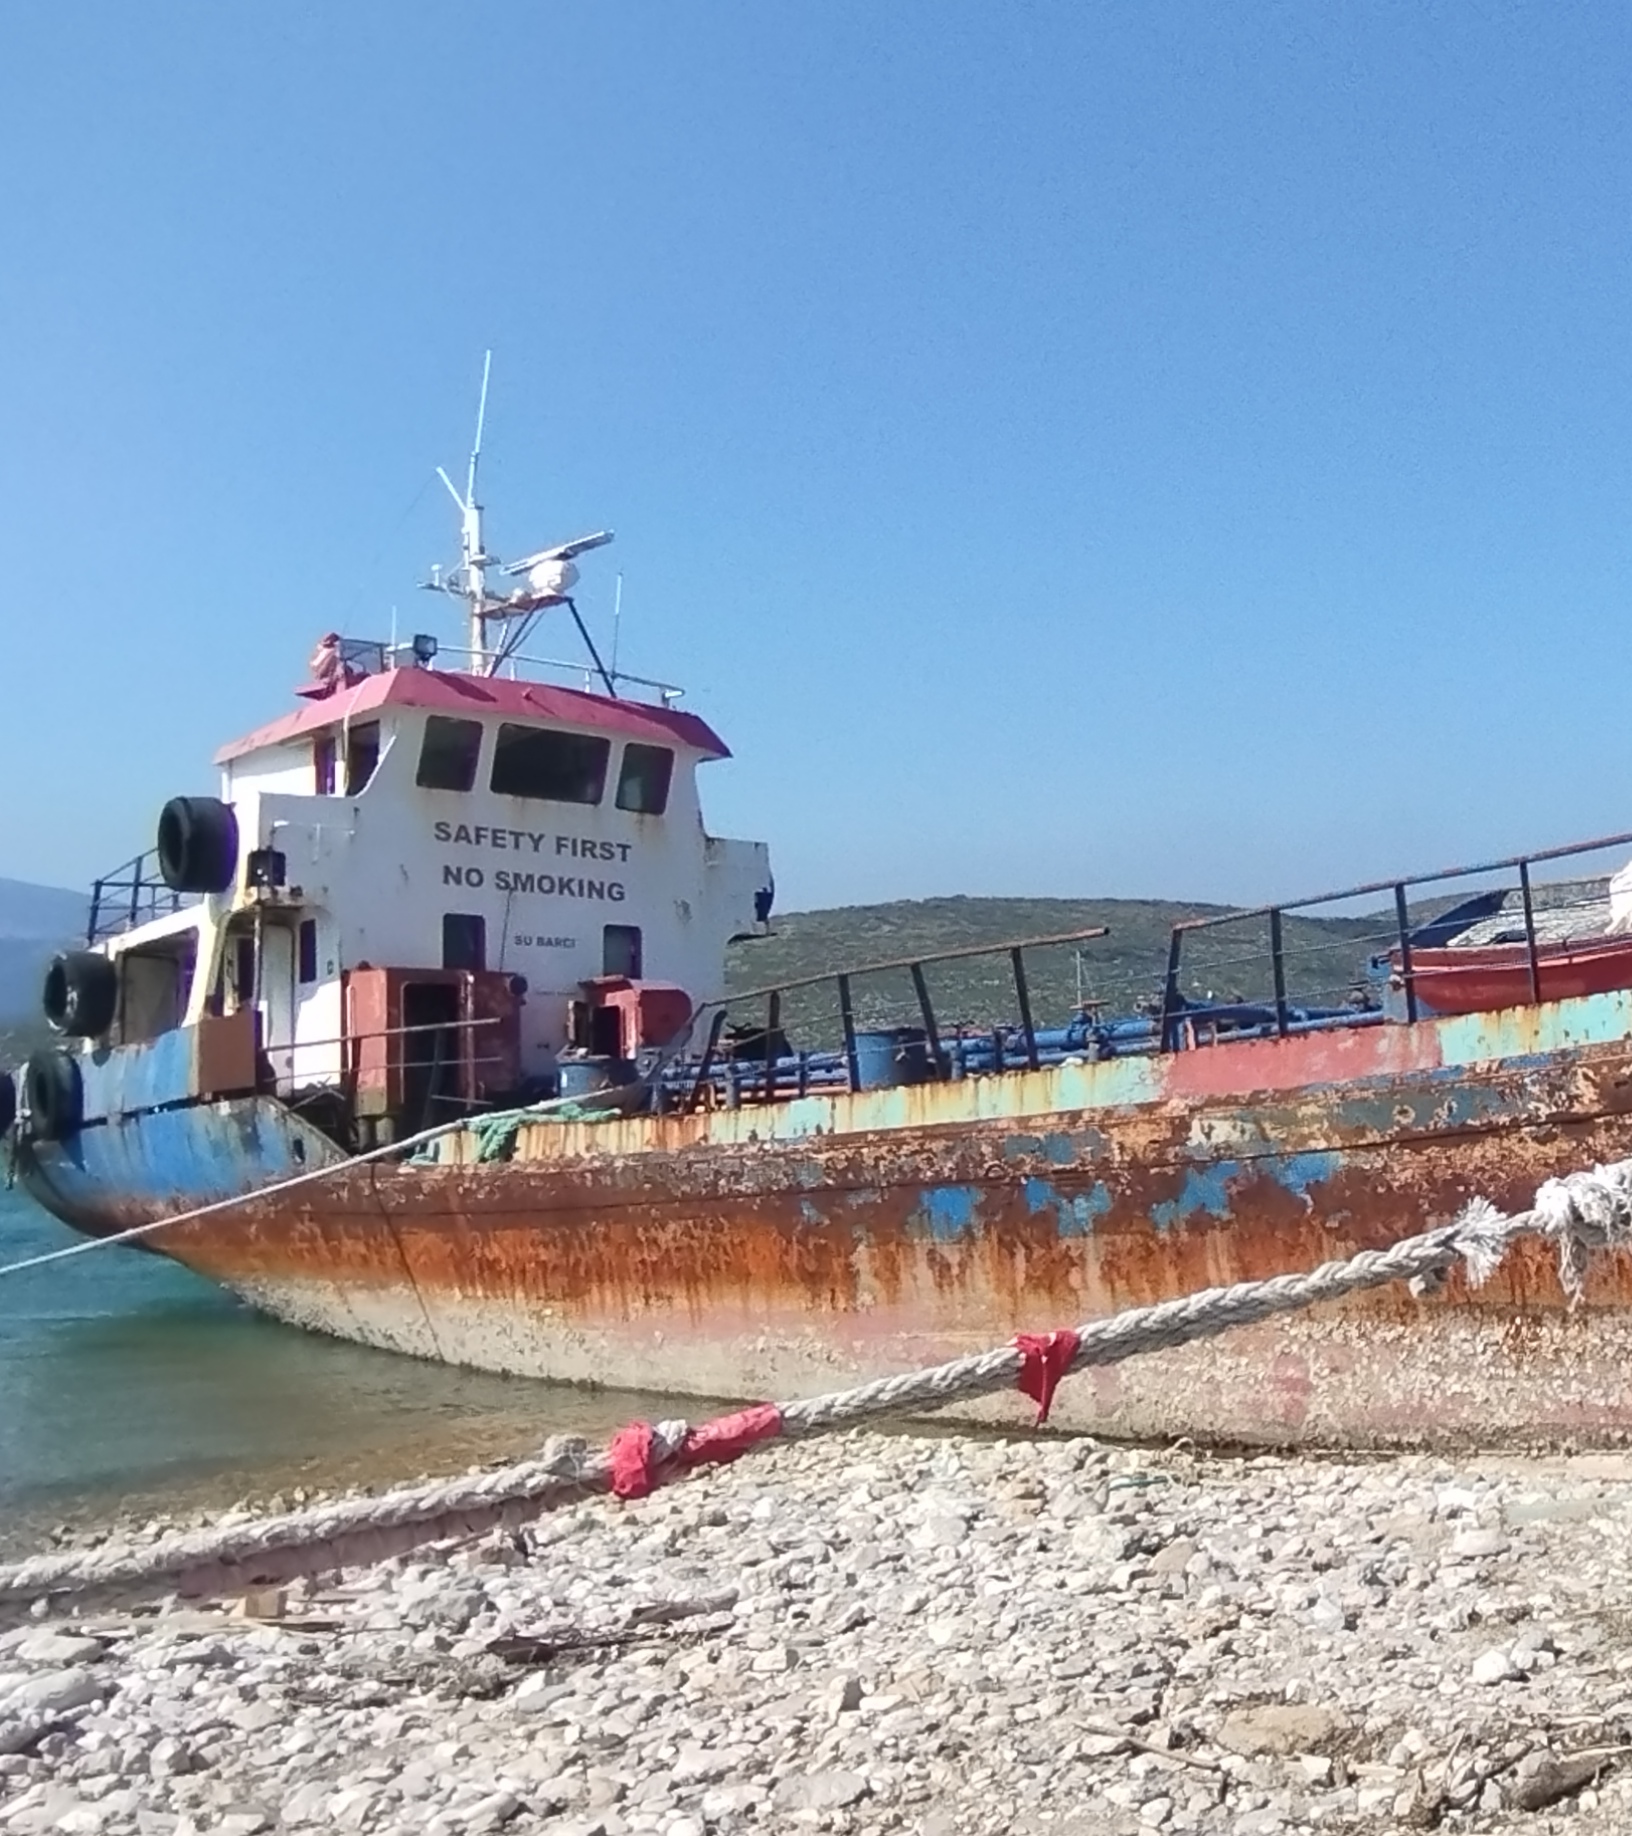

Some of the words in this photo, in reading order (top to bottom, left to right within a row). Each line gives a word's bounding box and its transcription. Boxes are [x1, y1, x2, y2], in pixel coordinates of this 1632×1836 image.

[434, 821, 545, 852] SAFETY
[555, 836, 632, 862] FIRST
[443, 865, 484, 887] NO
[495, 870, 626, 901] SMOKING
[514, 935, 533, 946] SU
